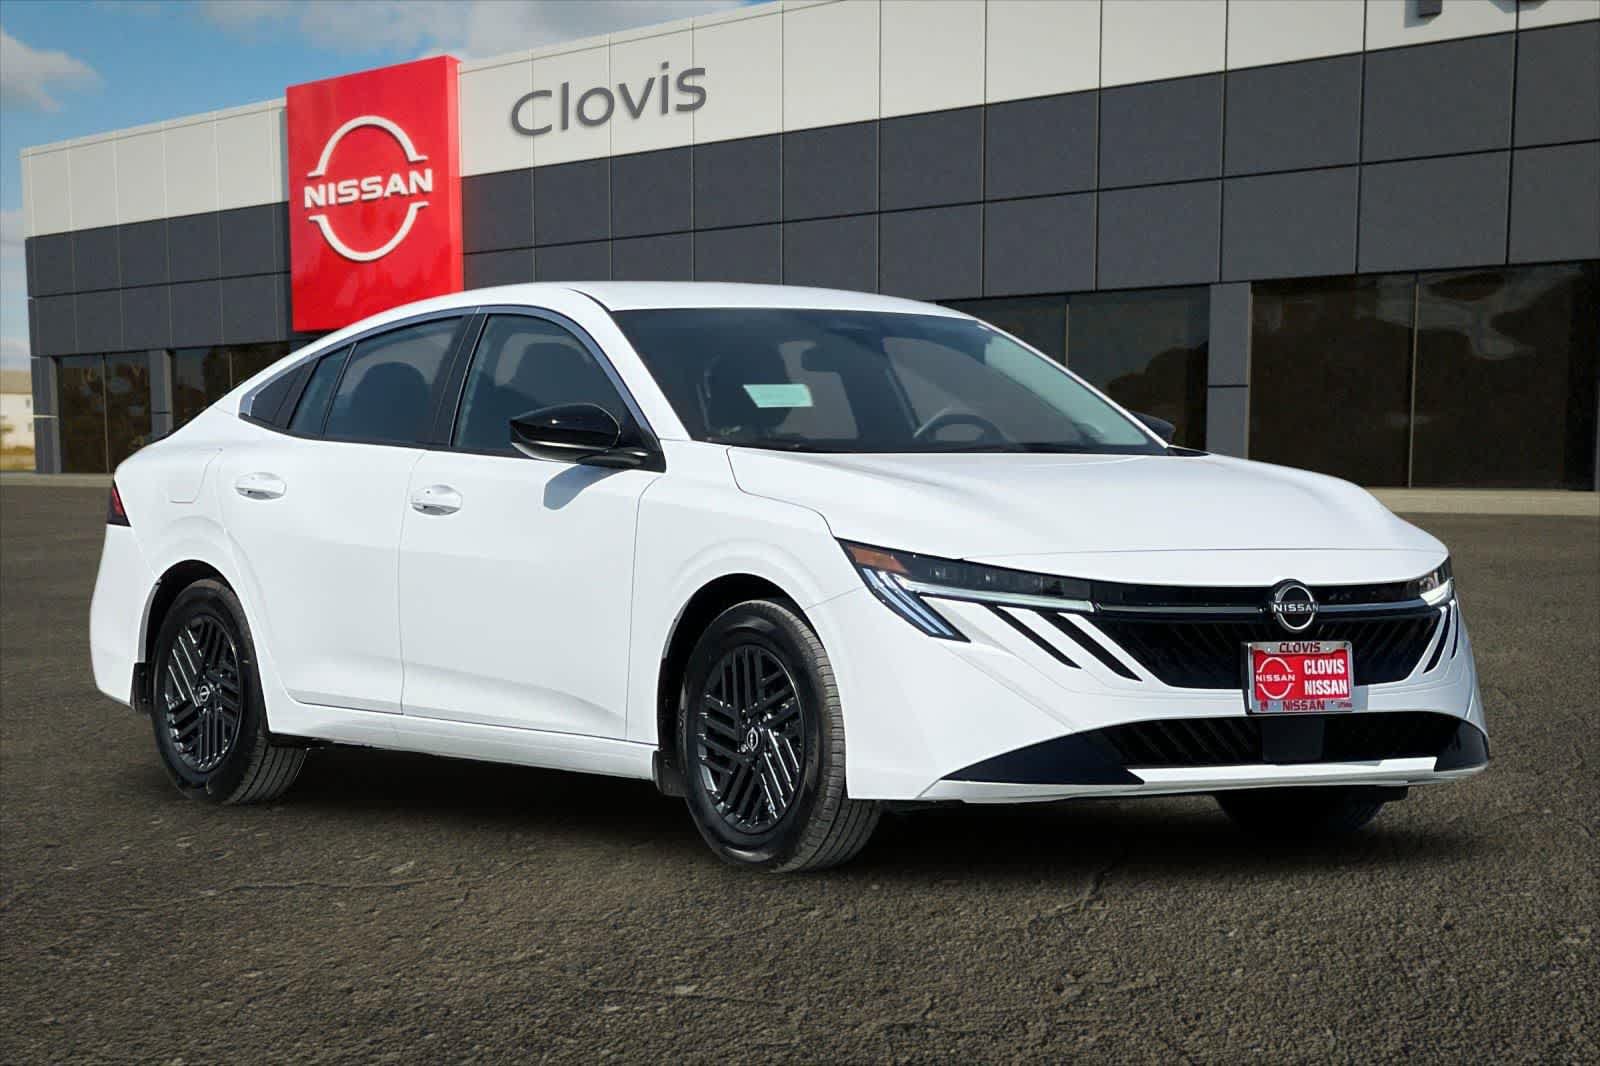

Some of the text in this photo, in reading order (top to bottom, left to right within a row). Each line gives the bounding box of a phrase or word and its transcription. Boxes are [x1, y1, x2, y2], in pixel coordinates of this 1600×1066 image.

[511, 62, 707, 136] Clovis
[303, 168, 433, 208] NISSAN
[1273, 603, 1319, 612] NISSAN
[1279, 642, 1321, 653] CLOVIS
[1304, 659, 1344, 675] CLOVIS
[1256, 674, 1296, 682] NISSAN
[1304, 680, 1348, 695] NISSAN
[1282, 700, 1325, 712] NISSAN
